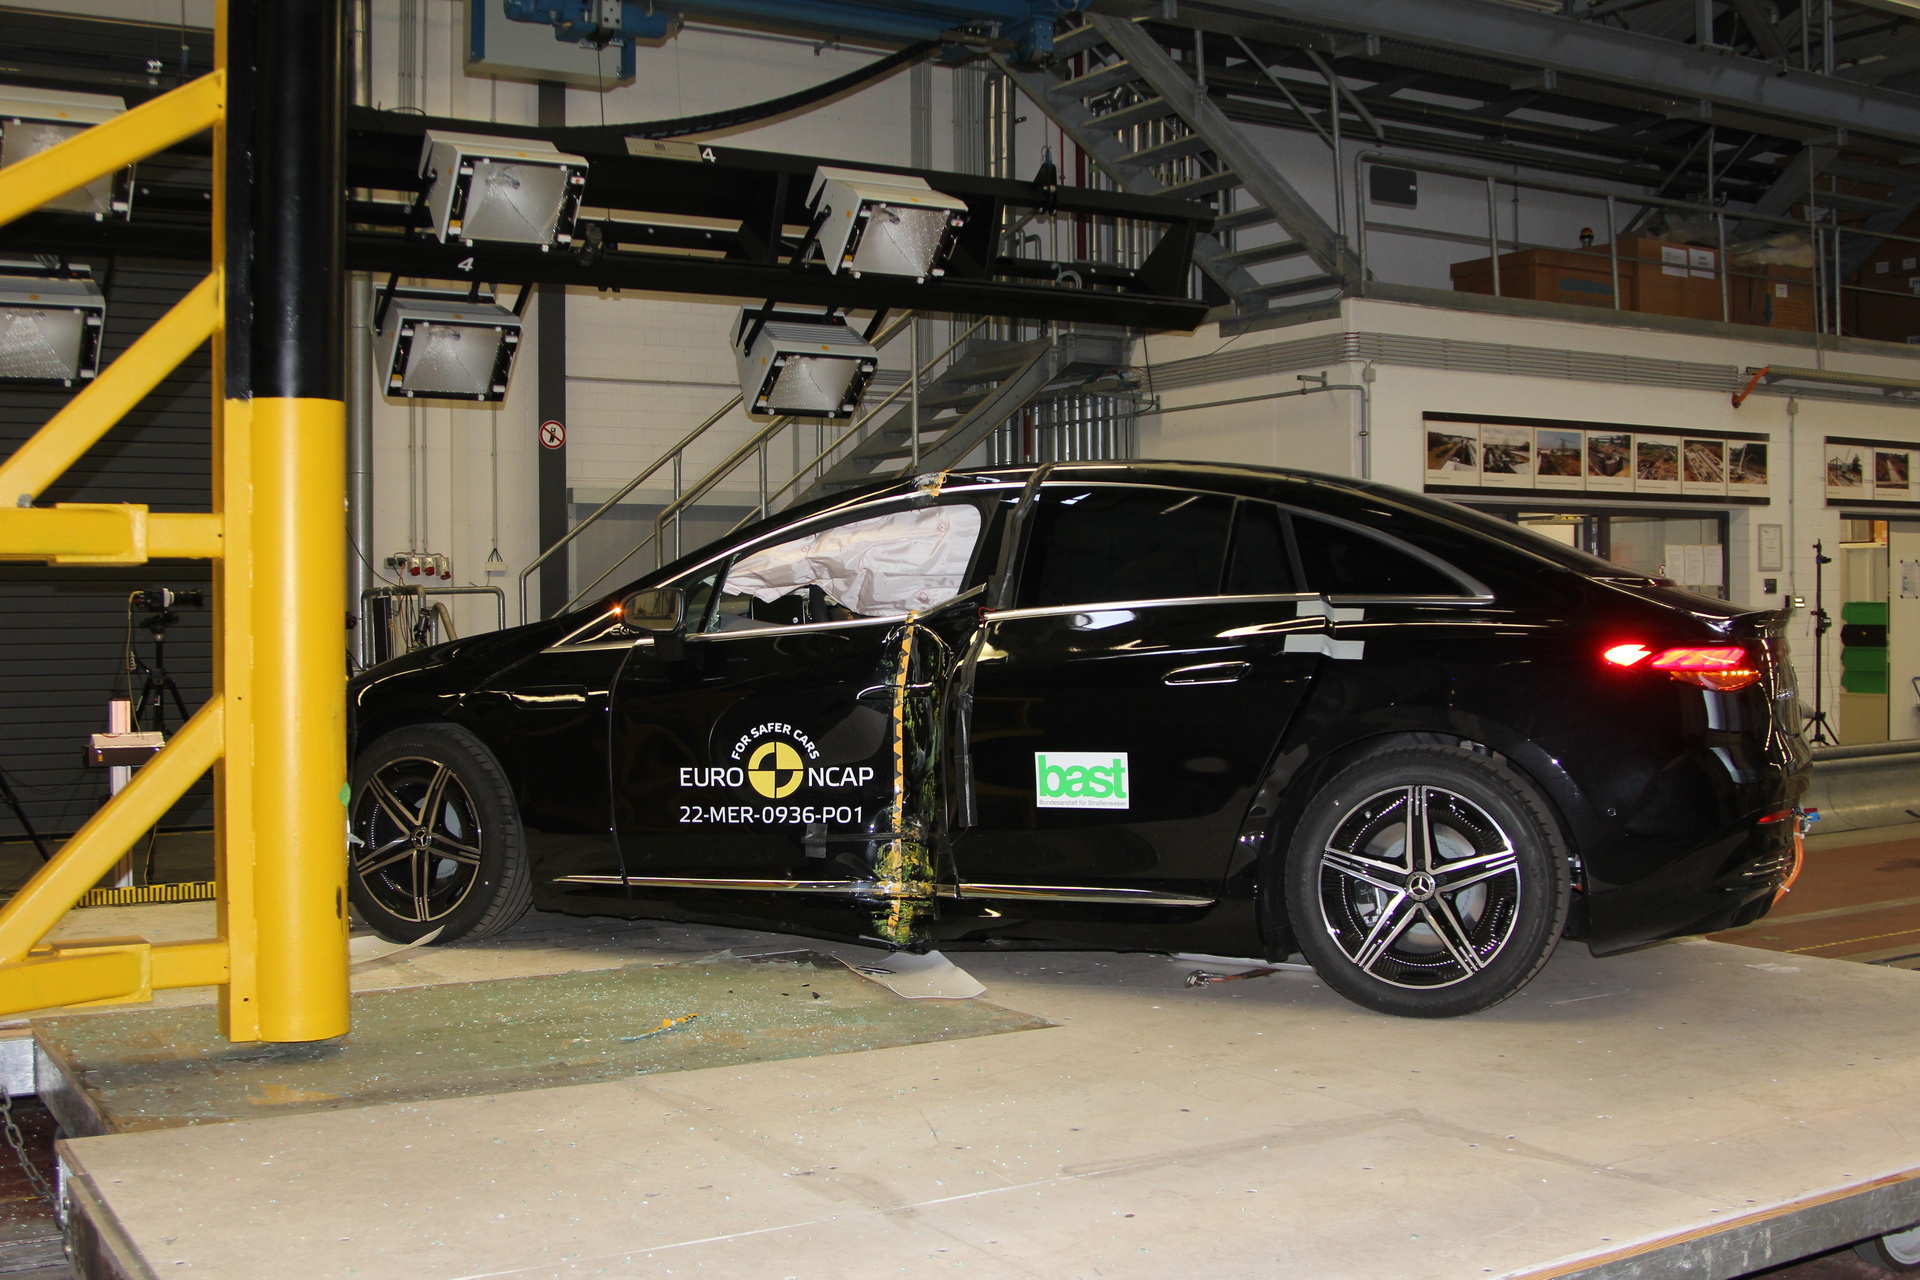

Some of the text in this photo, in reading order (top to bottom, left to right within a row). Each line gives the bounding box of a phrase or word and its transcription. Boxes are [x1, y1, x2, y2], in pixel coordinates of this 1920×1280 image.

[702, 147, 717, 163] 4
[457, 257, 474, 271] 4
[731, 722, 820, 760] FOR SAFER CARS
[680, 767, 874, 787] EURO NCAP
[1038, 755, 1127, 799] bast
